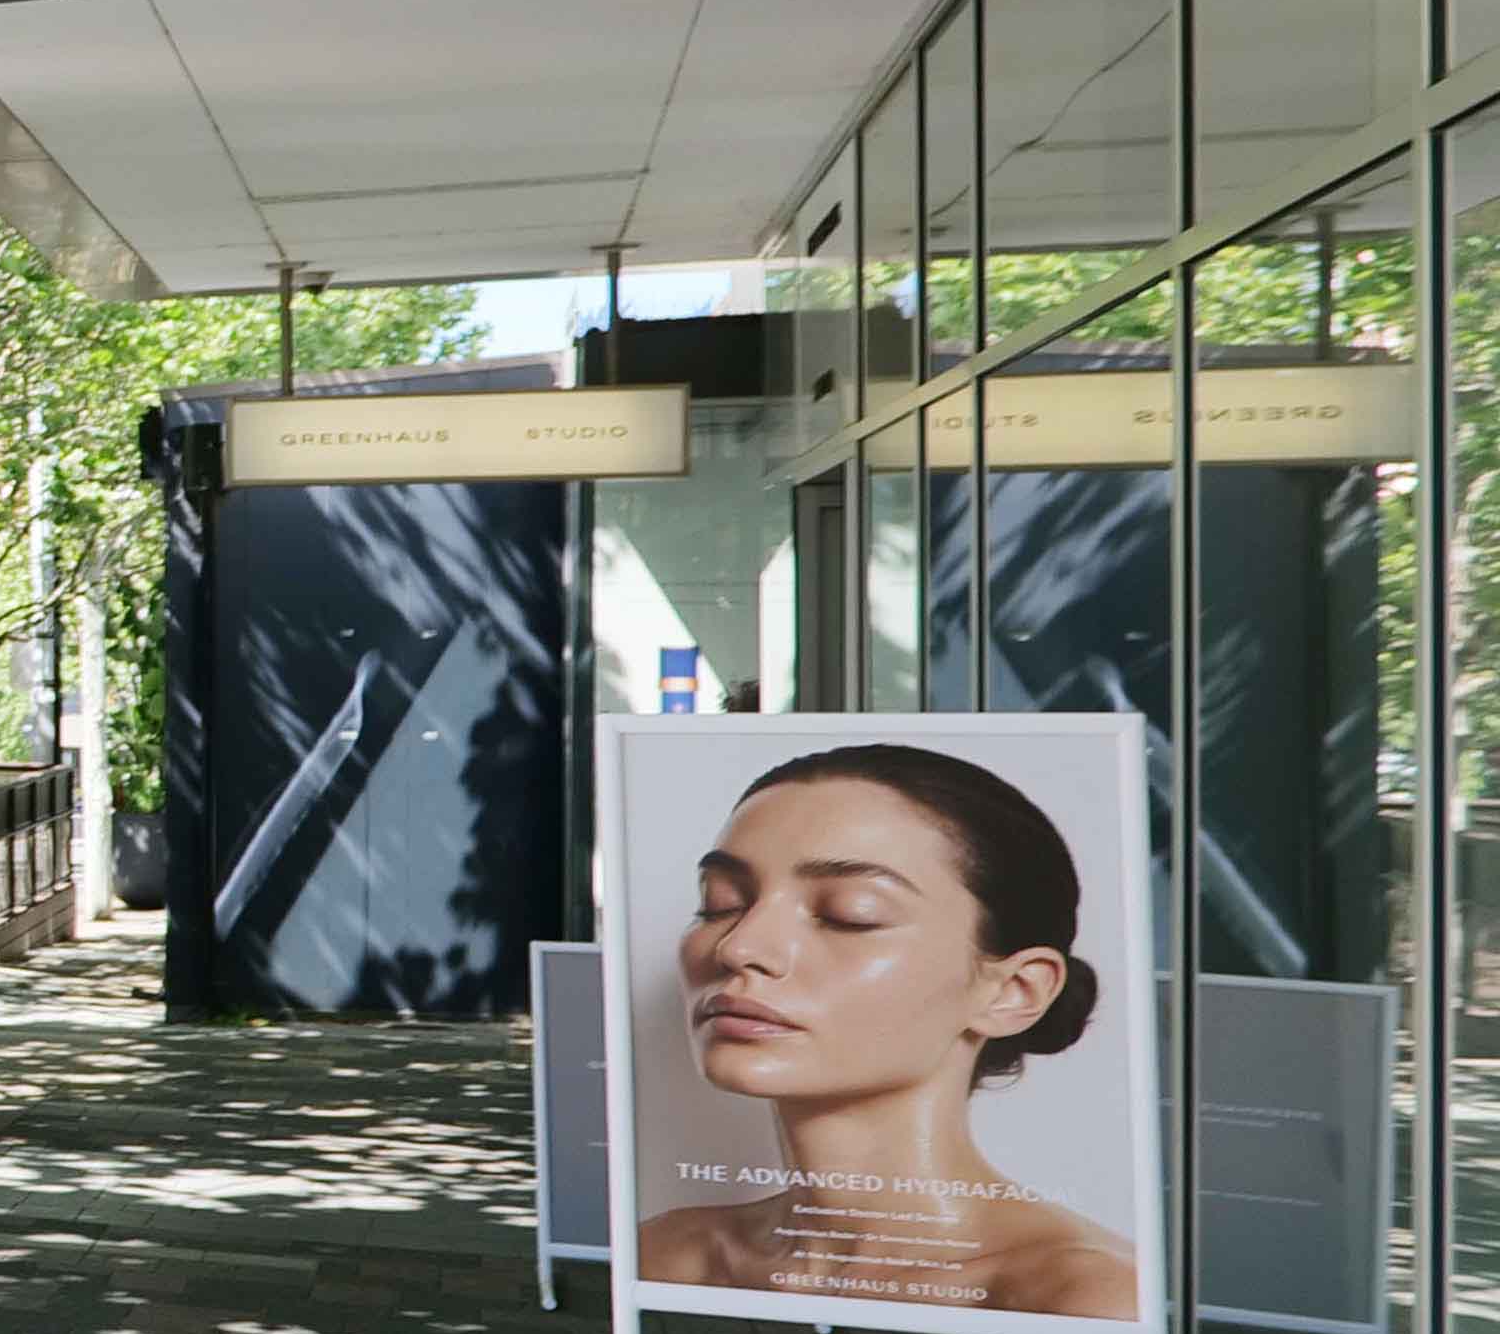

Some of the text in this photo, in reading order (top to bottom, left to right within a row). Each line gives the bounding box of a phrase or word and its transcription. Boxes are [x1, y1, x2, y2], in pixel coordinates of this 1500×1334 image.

[279, 424, 630, 447] GREENHAUS STUDIO
[675, 1161, 728, 1183] THE
[735, 1166, 885, 1194] ADVANCED
[769, 1271, 989, 1302] GREENHAUS STUDIO
